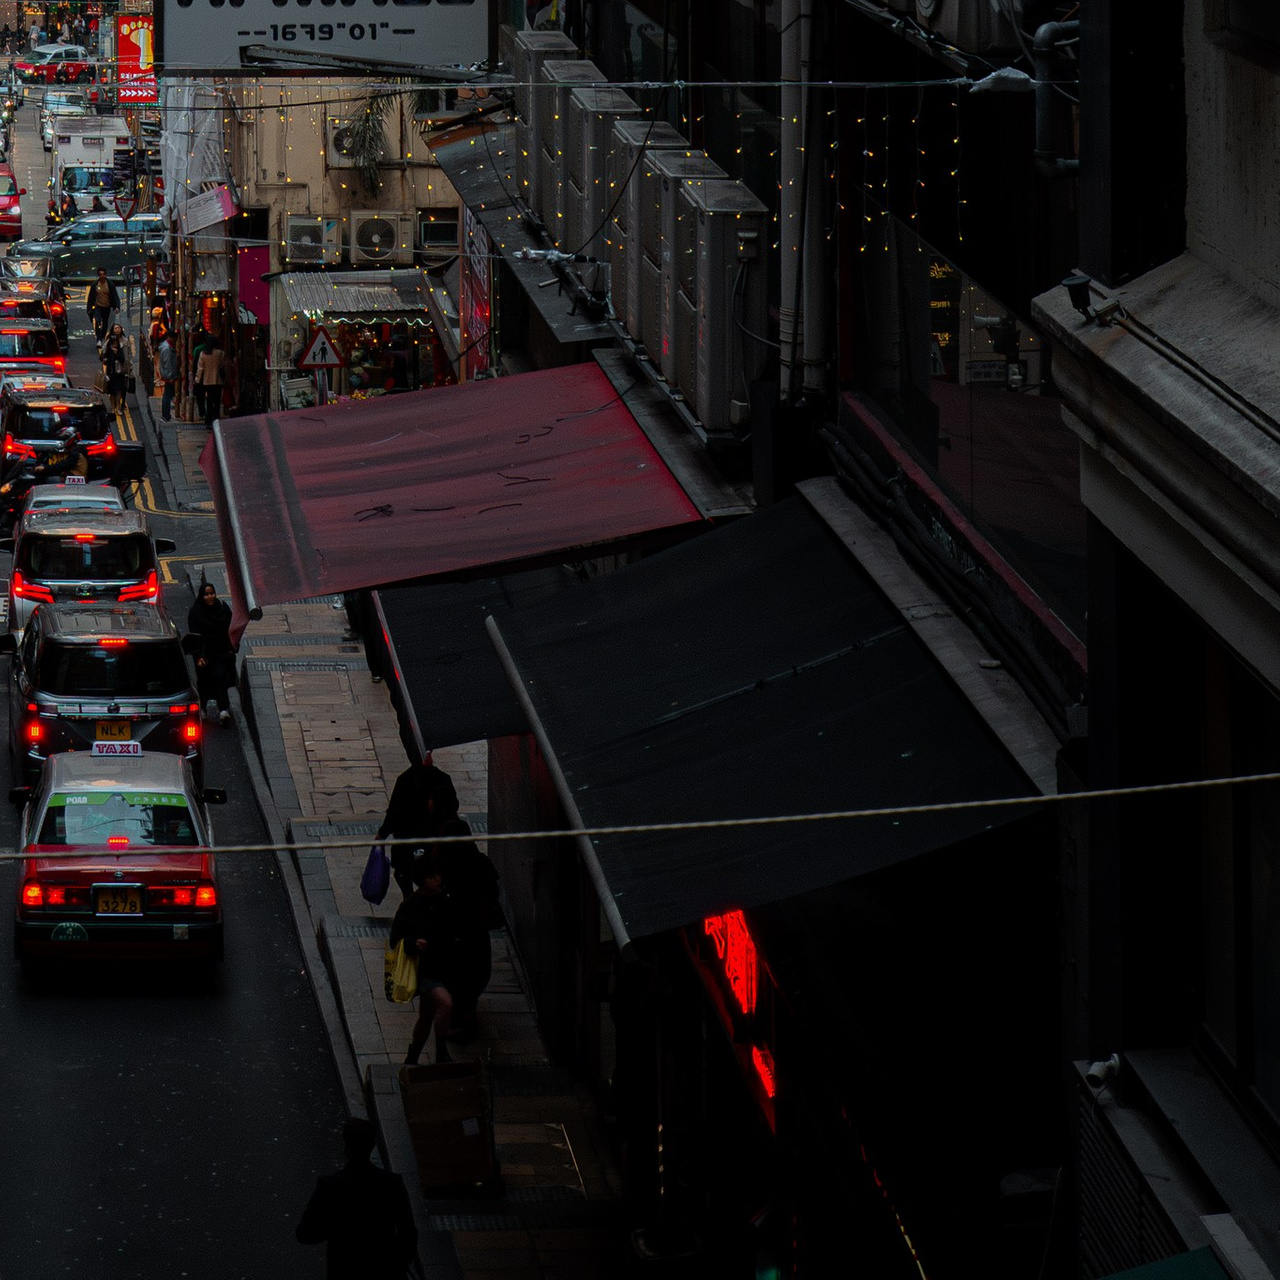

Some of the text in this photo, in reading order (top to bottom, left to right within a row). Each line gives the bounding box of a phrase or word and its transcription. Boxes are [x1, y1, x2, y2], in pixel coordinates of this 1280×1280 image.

[101, 726, 125, 736] NLK
[96, 744, 139, 754] TAXI
[102, 900, 138, 912] 3278
